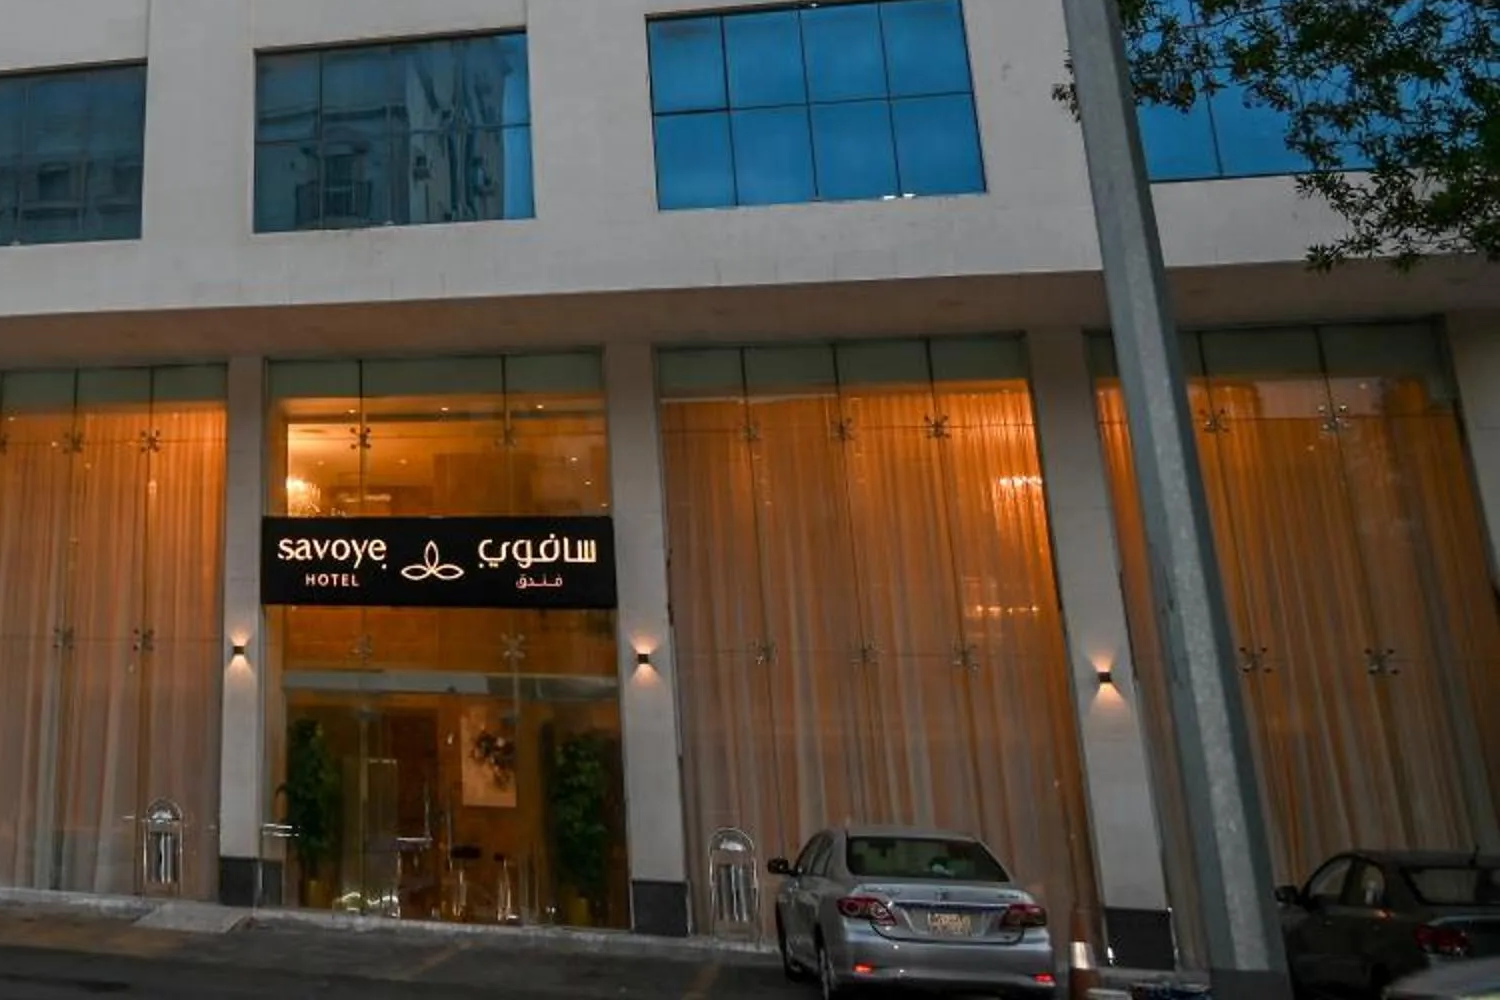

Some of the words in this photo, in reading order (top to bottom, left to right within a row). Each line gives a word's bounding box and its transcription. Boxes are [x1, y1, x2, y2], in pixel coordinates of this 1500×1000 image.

[478, 533, 596, 568] سافوي
[305, 574, 360, 587] HOTEL
[516, 575, 563, 589] فندق
